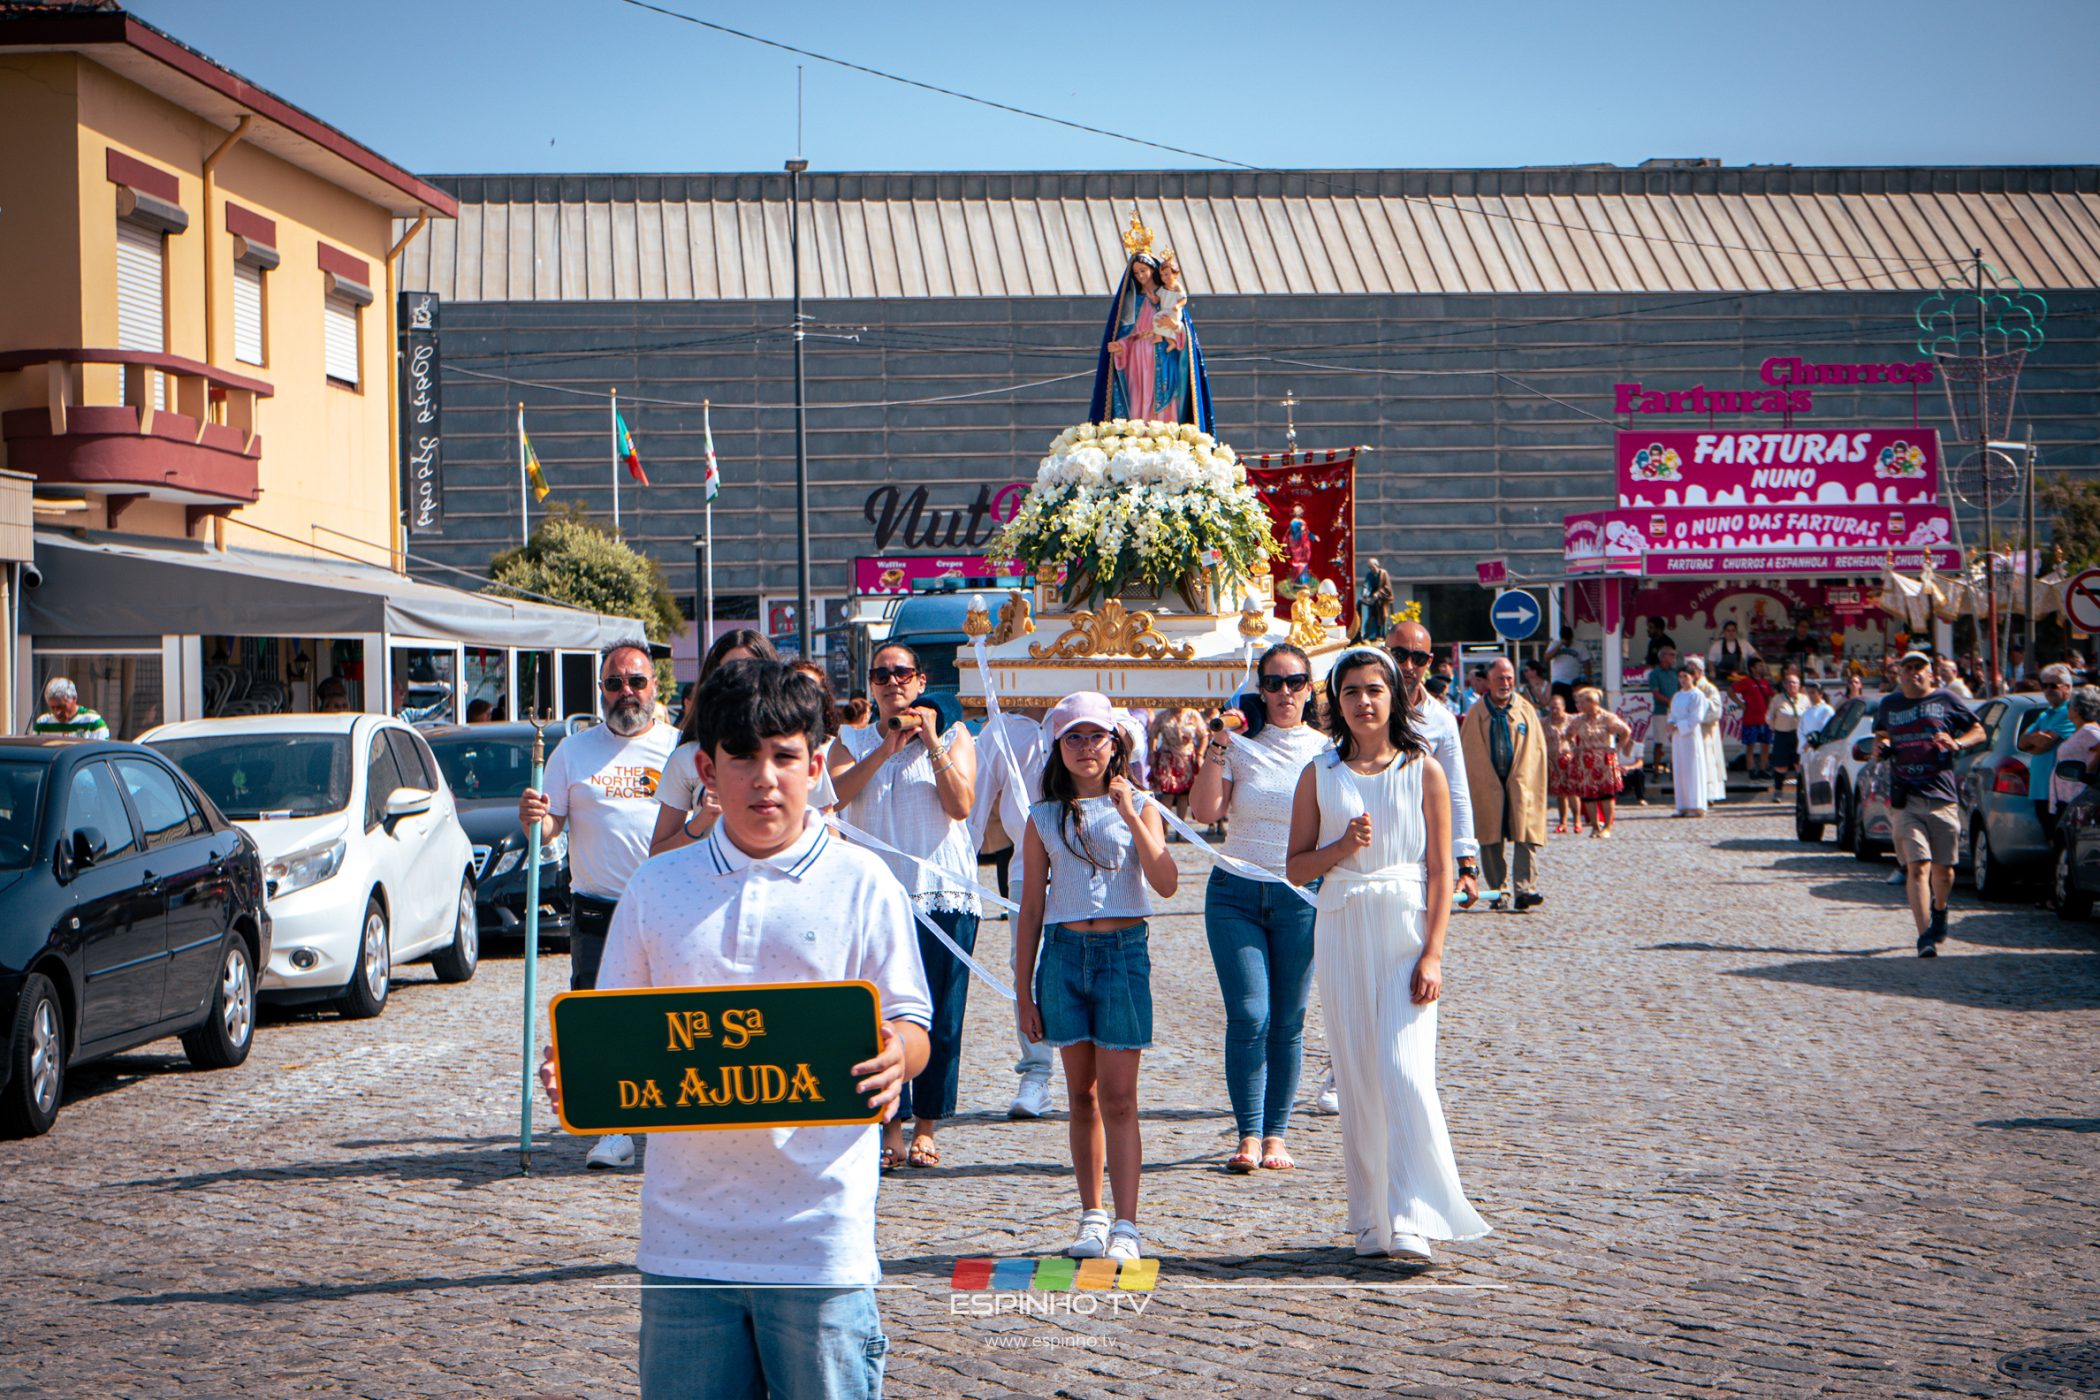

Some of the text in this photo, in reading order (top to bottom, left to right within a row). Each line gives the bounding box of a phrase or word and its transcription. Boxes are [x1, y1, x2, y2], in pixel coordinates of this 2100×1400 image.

[1760, 357, 1935, 386] Churros
[1613, 384, 1813, 414] Farturas
[1693, 432, 1872, 465] FARTURAS
[1750, 467, 1816, 489] NUNO
[1674, 513, 1882, 539] O NUNO DAS FARTURAS
[876, 560, 964, 569] Waffles Crepes
[1667, 557, 1714, 571] FARTURAS
[1722, 557, 1766, 570] CHURROS
[1775, 556, 1829, 570] ESPANHOLA
[591, 774, 641, 788] NORTH
[614, 765, 642, 777] THE
[605, 785, 642, 799] FACE
[617, 1062, 827, 1109] DA AJUDA
